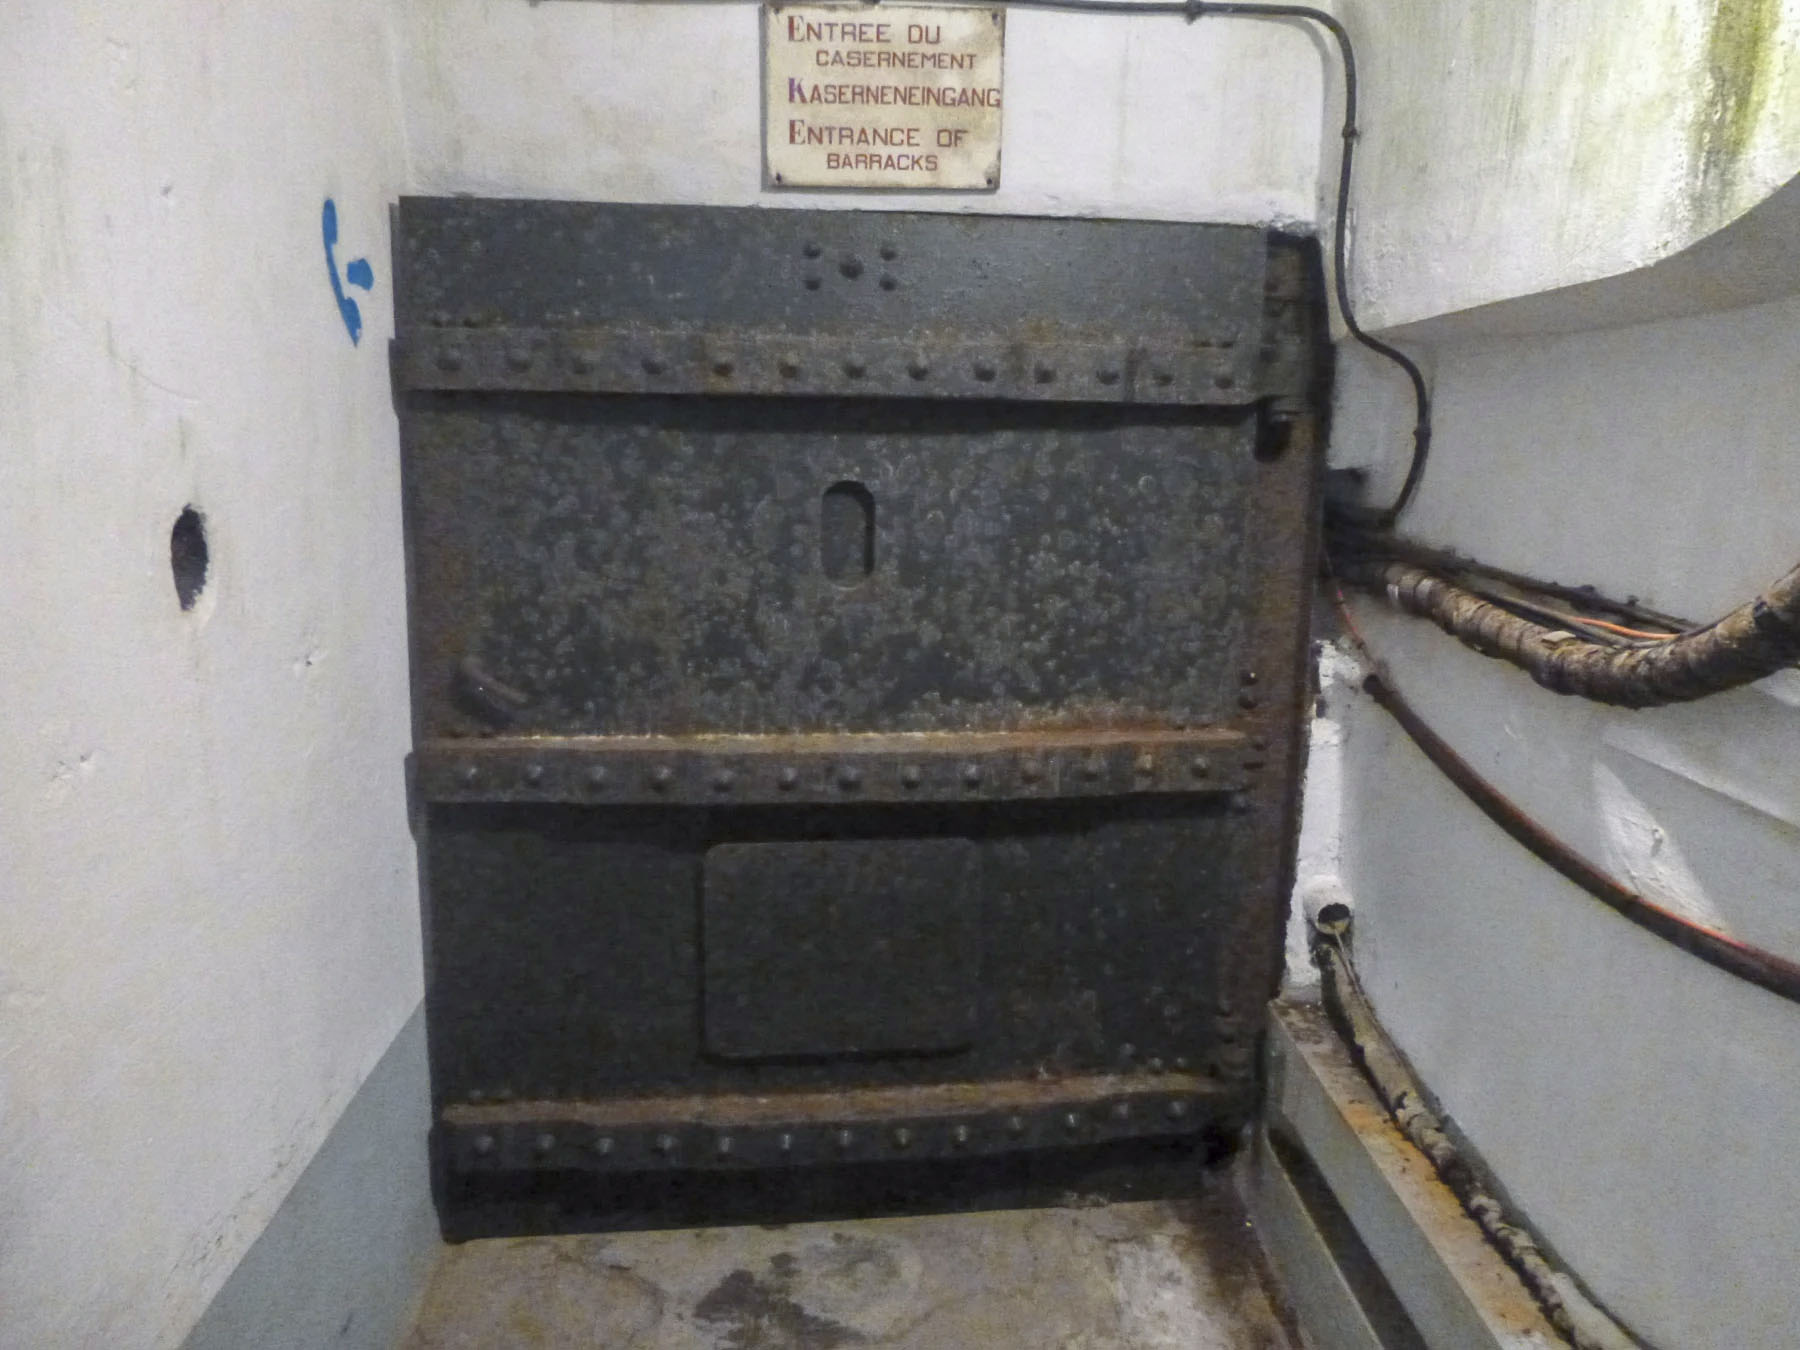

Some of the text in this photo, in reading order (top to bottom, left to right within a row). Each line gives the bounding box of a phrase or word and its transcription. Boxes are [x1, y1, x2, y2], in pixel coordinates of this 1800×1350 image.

[787, 15, 941, 45] ENTREE DU
[815, 50, 977, 70] CASERNEMENT
[788, 77, 1001, 108] KASERNENEINGANG
[788, 119, 968, 148] ENTRANCE OF
[826, 153, 938, 171] BARRACKS
